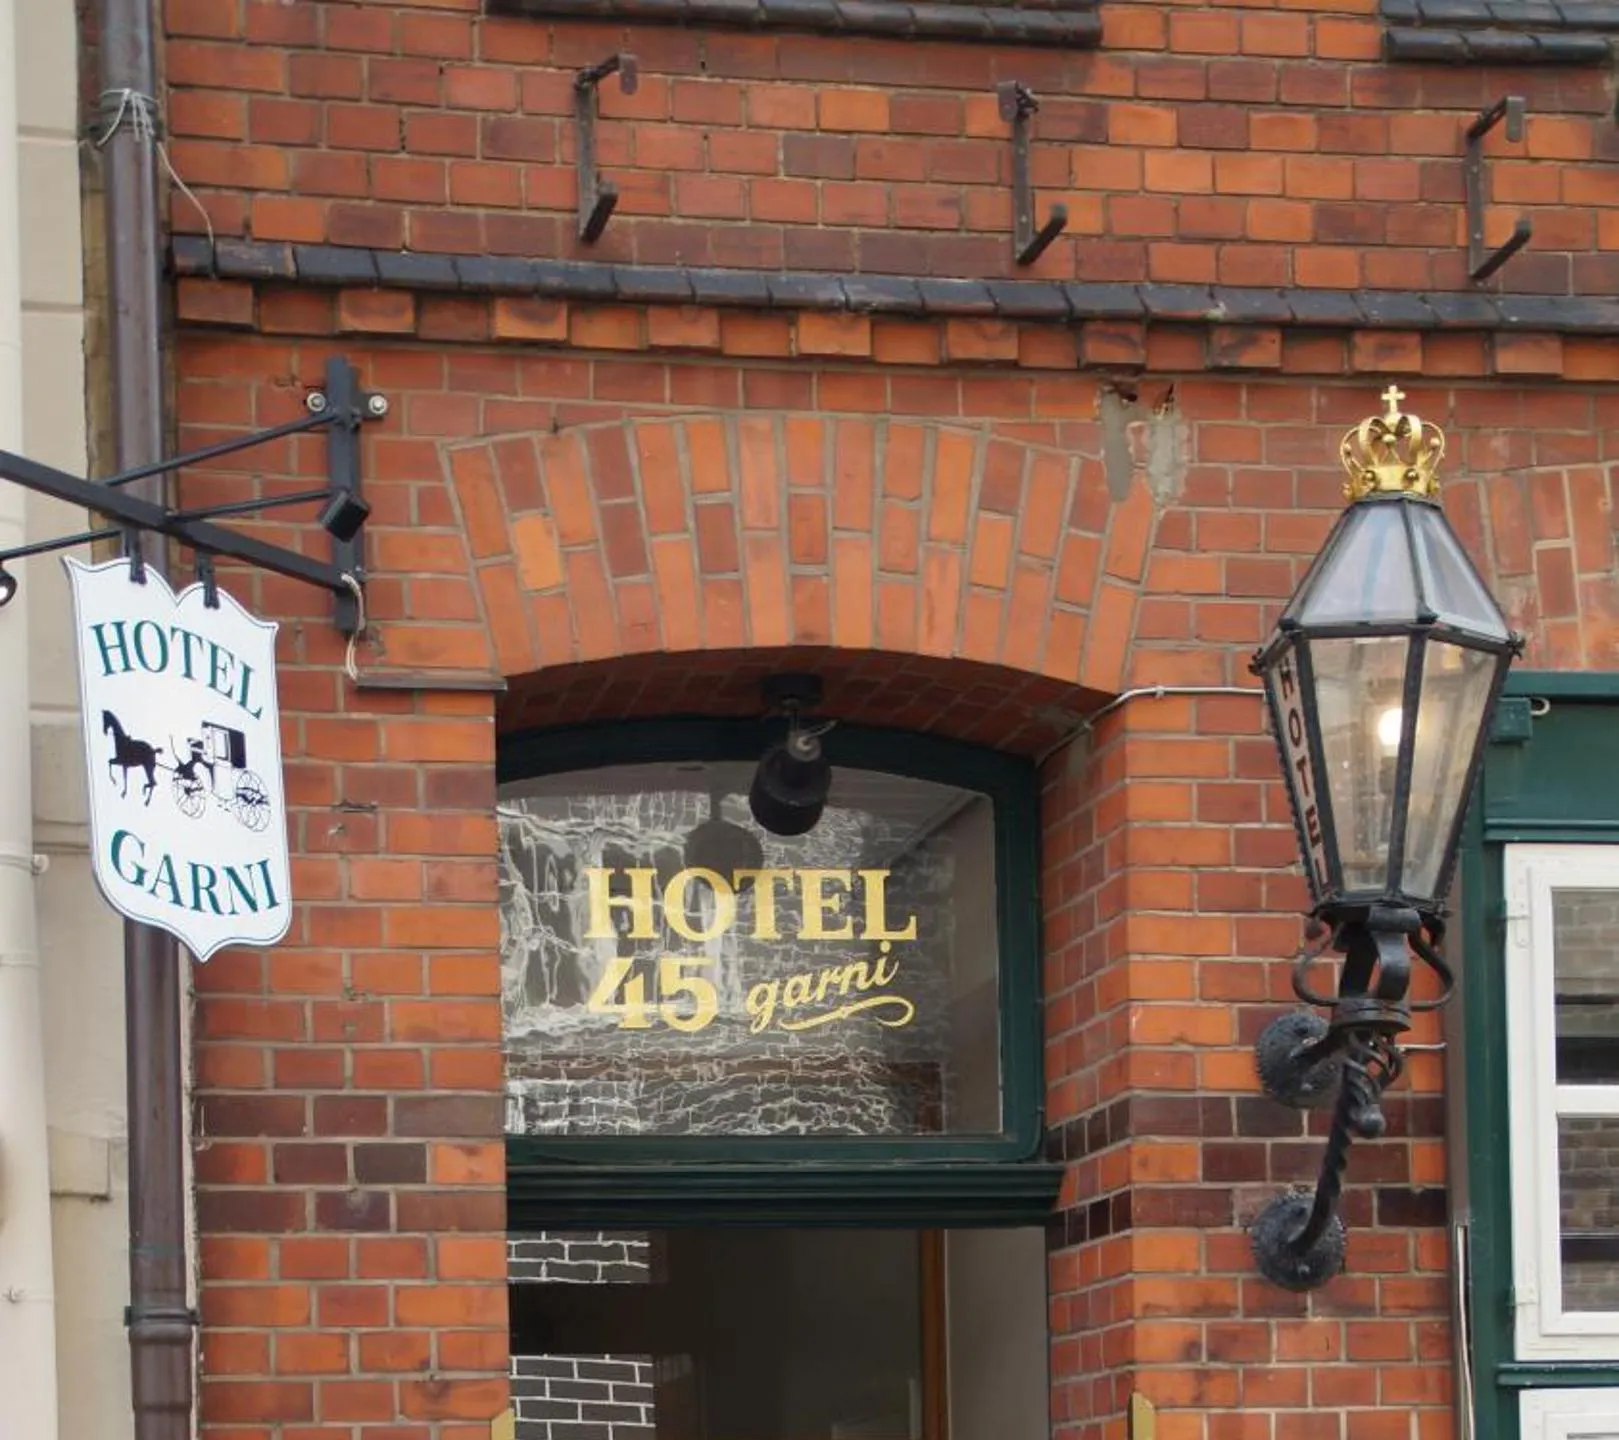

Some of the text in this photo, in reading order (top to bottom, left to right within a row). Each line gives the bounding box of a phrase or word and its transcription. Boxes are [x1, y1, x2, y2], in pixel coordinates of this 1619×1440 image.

[90, 619, 263, 719] HOTEL
[1278, 656, 1333, 897] HOTEL
[110, 828, 281, 916] GARNI
[583, 867, 918, 942] HOTEL
[587, 940, 902, 1034] 45 garni
